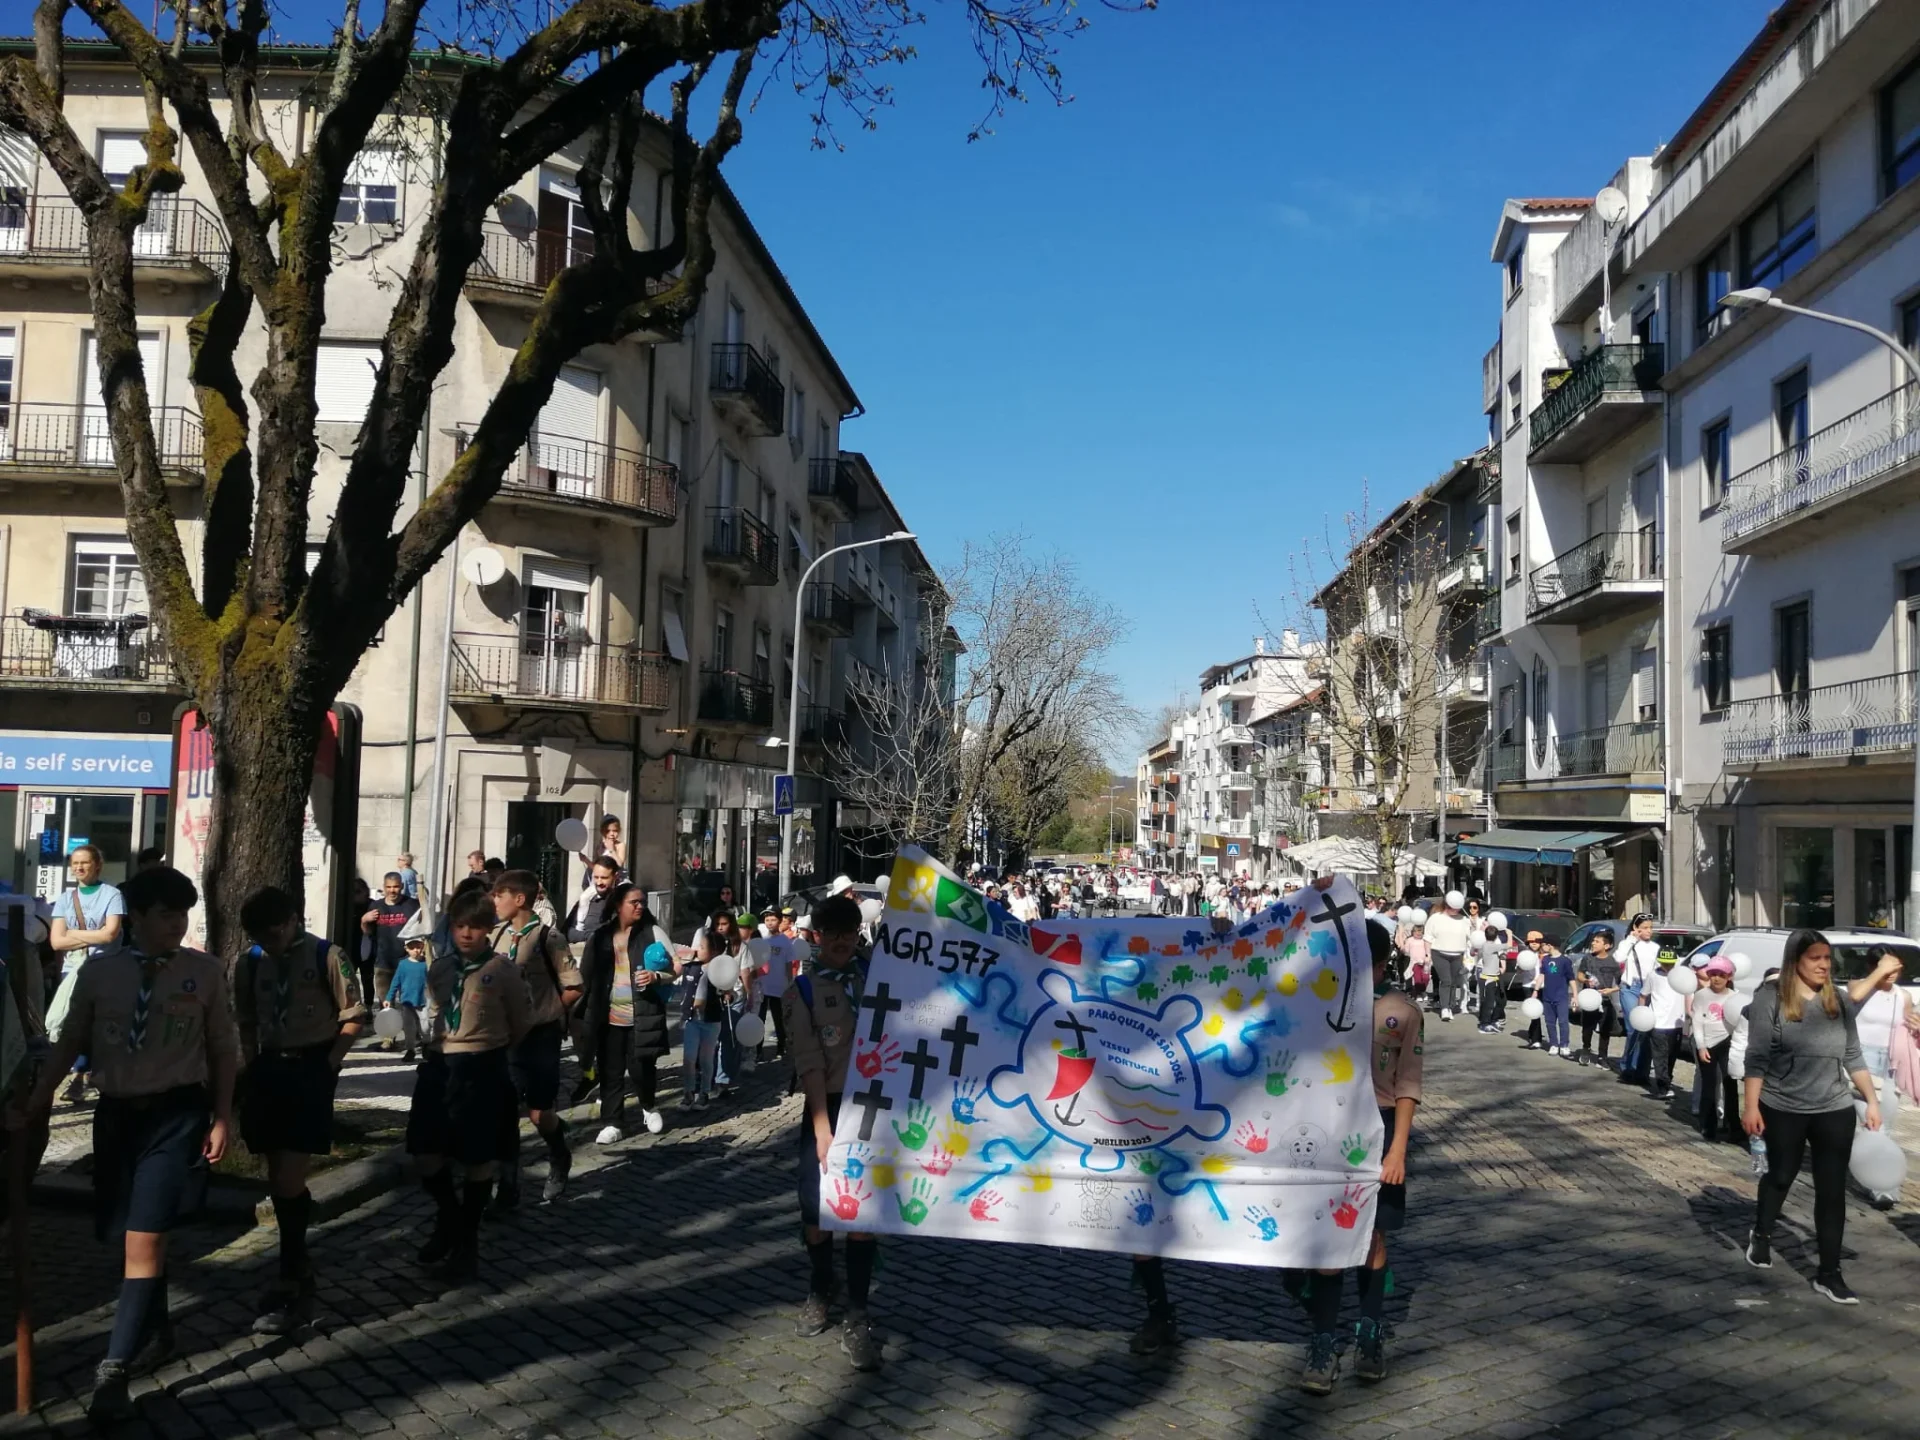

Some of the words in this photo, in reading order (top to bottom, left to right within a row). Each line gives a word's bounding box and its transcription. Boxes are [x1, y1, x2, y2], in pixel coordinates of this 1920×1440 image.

[25, 753, 66, 771] self
[71, 754, 153, 773] service
[546, 786, 560, 795] 102
[1099, 1038, 1131, 1055] VISEU
[1108, 1054, 1160, 1076] PORTUGAL
[1145, 1027, 1161, 1042] DE
[1157, 1038, 1174, 1060] SÃO
[1169, 1059, 1187, 1085] JOSÉ
[1093, 1138, 1130, 1147] JUBILEU
[1130, 1135, 1152, 1146] 2025
